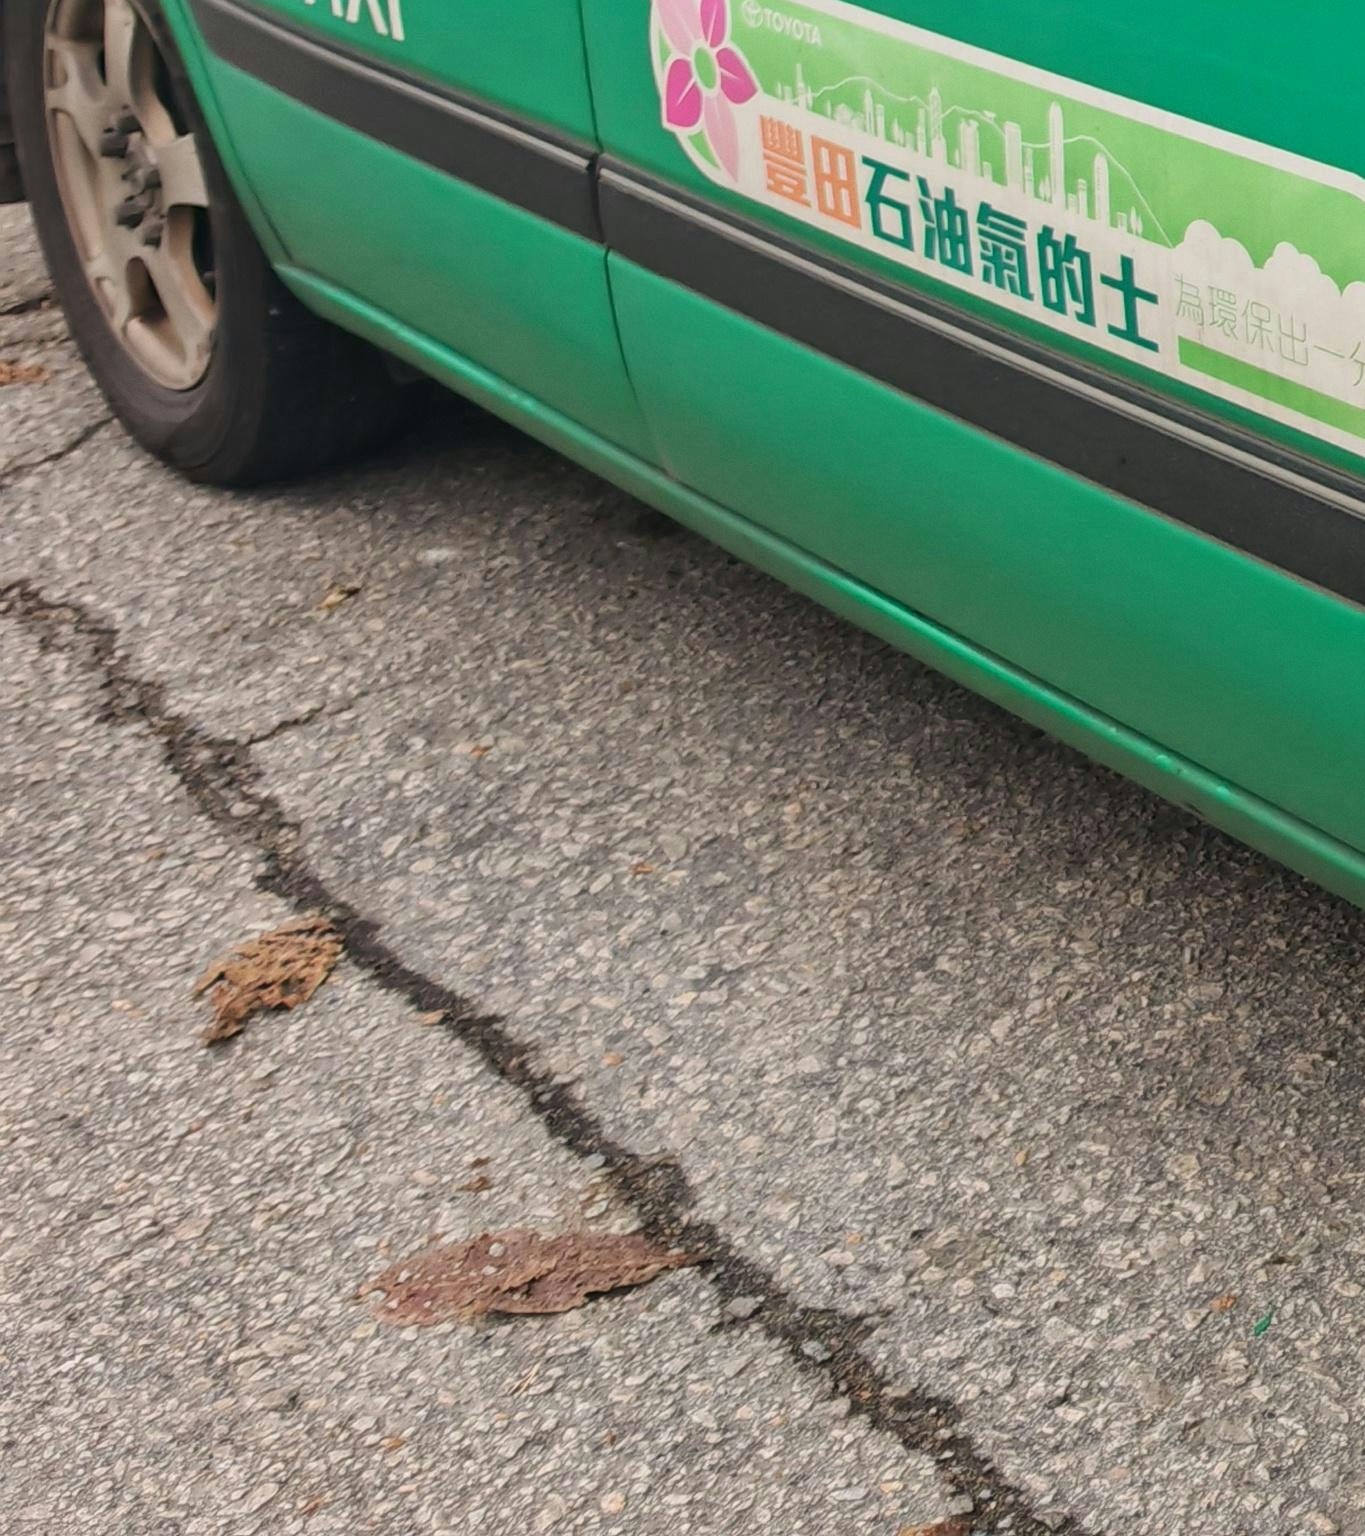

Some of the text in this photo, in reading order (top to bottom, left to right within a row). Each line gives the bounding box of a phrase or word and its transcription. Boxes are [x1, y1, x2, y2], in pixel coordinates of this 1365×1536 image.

[763, 7, 823, 48] TOYOTA
[759, 115, 1160, 354] 豐田石油氣的士
